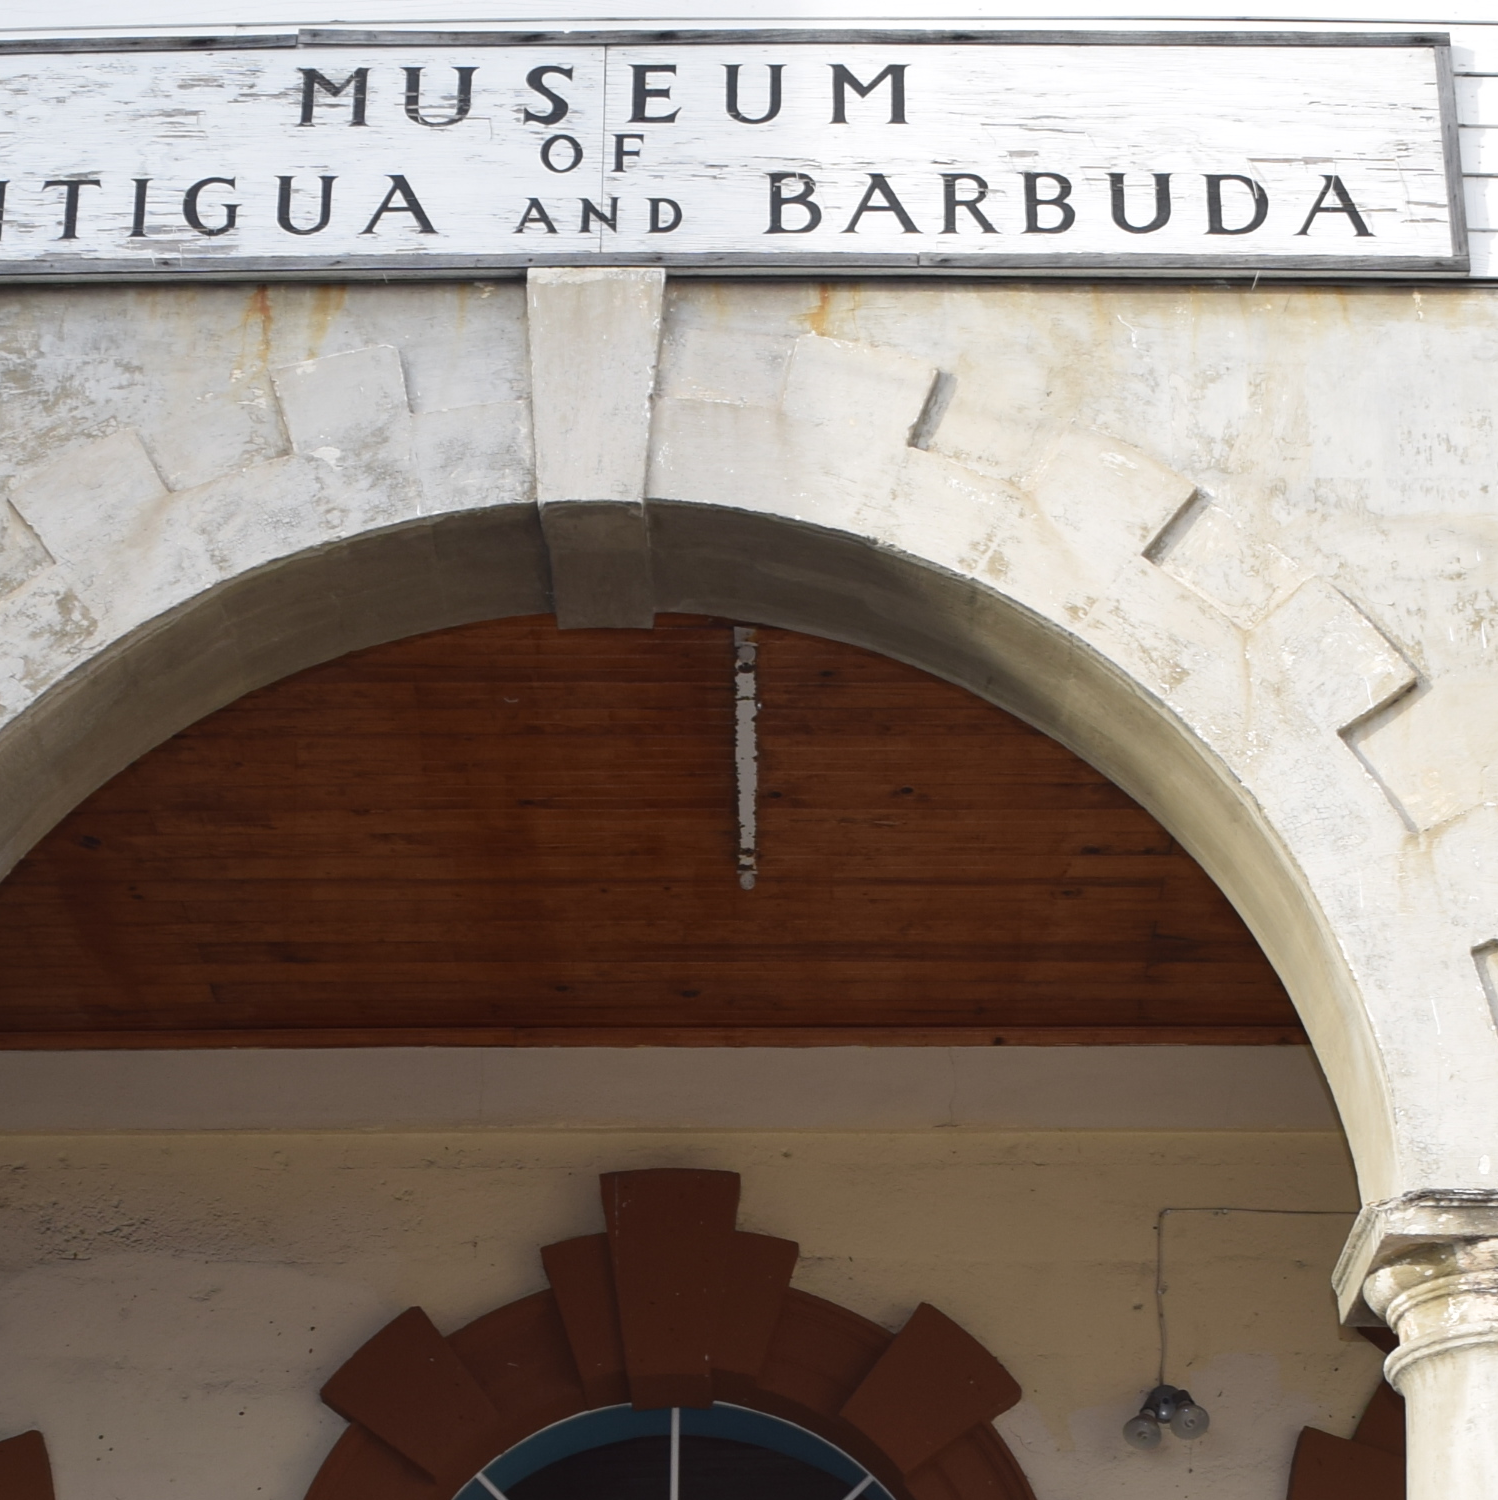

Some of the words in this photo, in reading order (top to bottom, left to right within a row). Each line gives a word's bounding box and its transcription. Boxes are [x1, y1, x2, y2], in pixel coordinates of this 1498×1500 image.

[298, 62, 912, 128] MUSEUM
[540, 132, 647, 174] OF
[511, 197, 686, 236] AND
[762, 170, 1376, 238] BARBUDA
